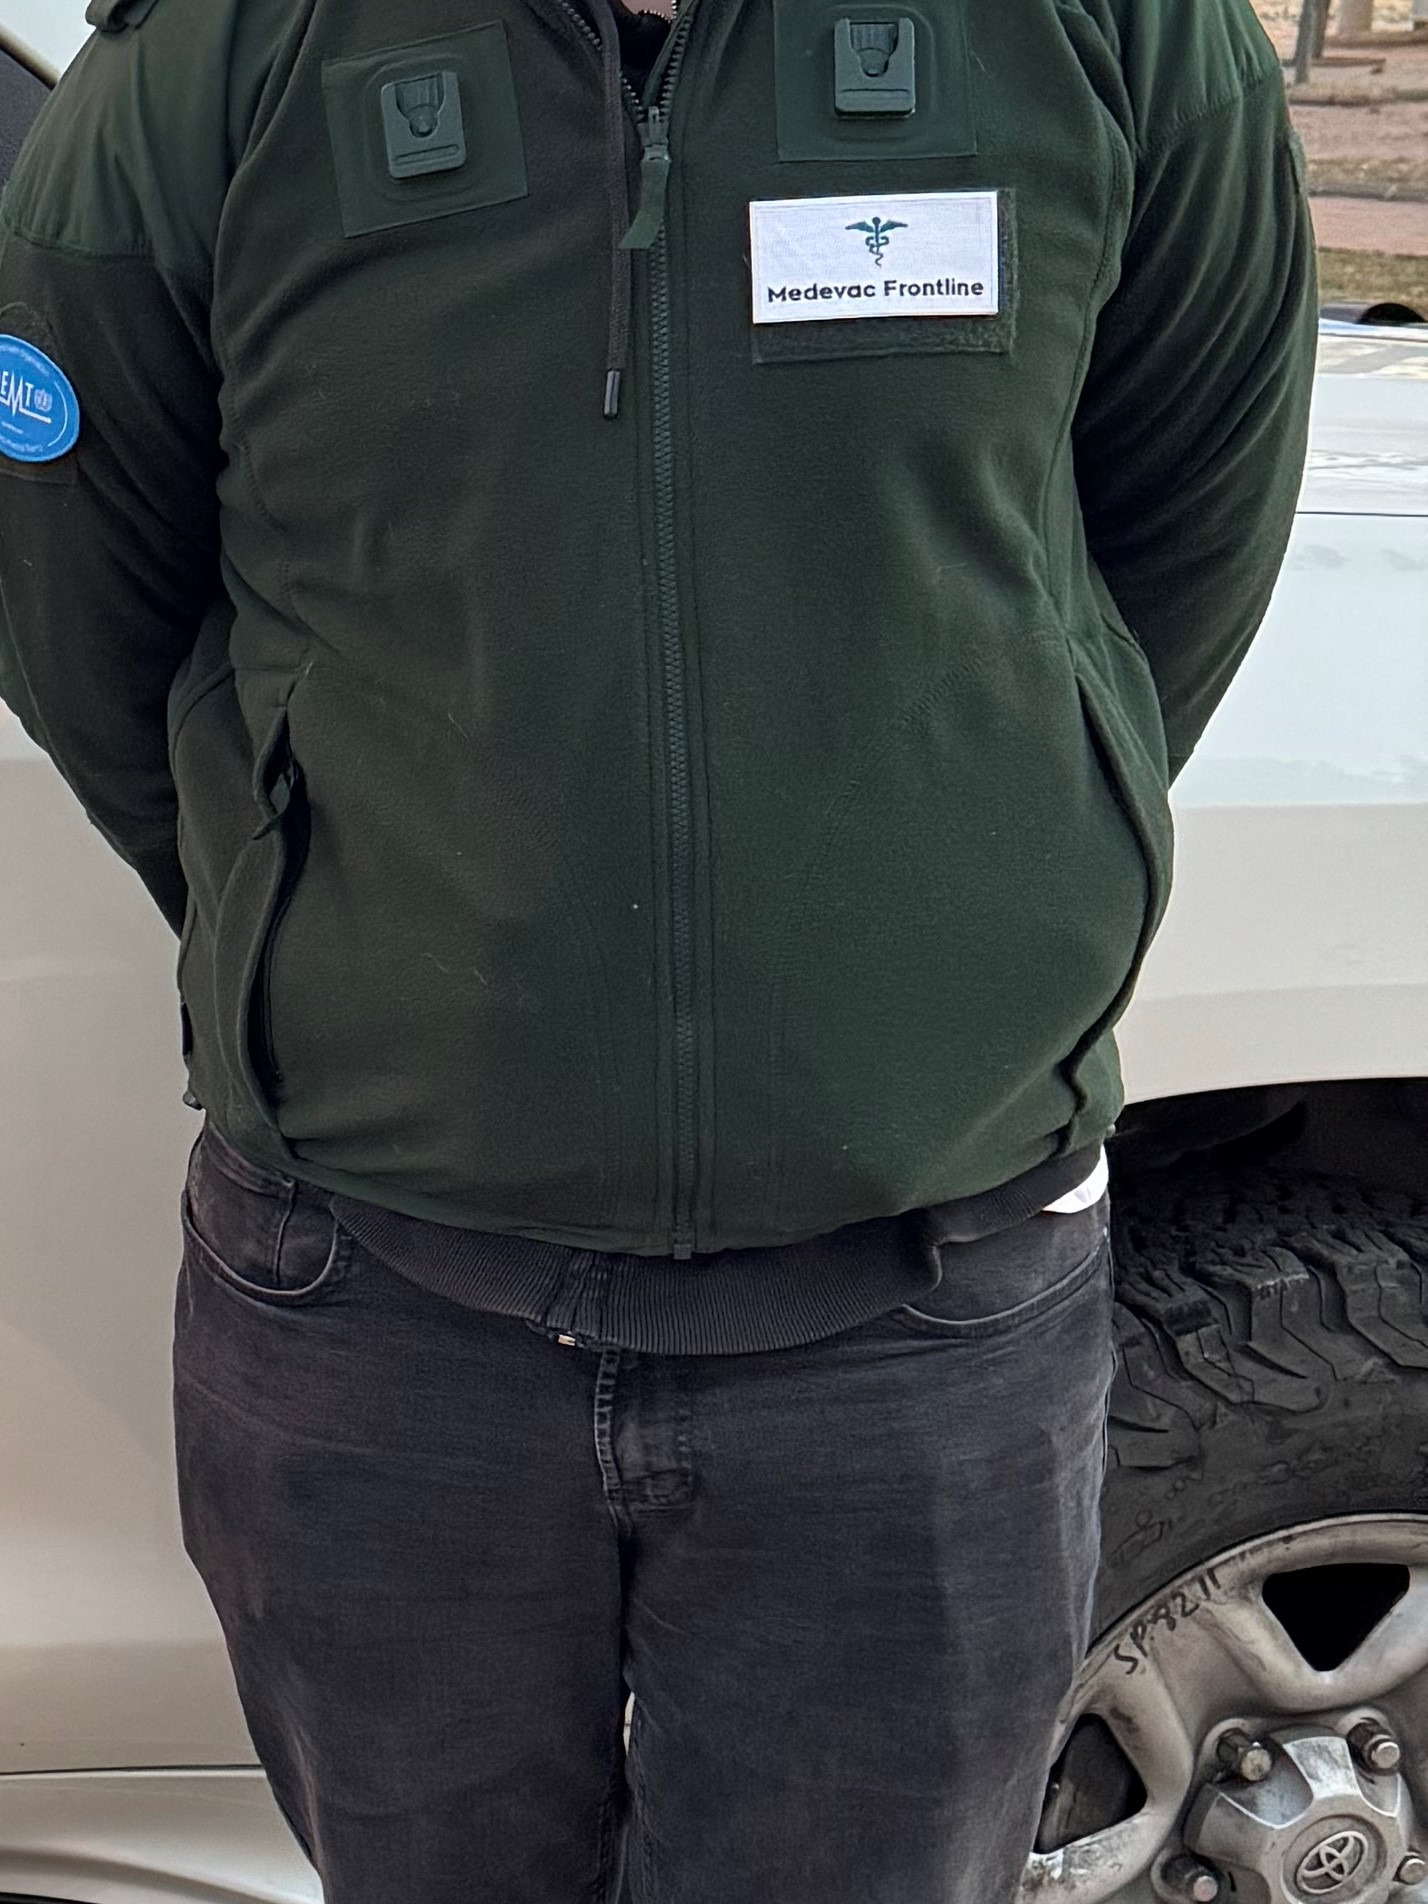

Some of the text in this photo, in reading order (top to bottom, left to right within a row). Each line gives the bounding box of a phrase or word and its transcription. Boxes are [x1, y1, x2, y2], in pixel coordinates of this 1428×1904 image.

[767, 277, 984, 303] Medevac Frontline
[1, 370, 35, 416] EMT
